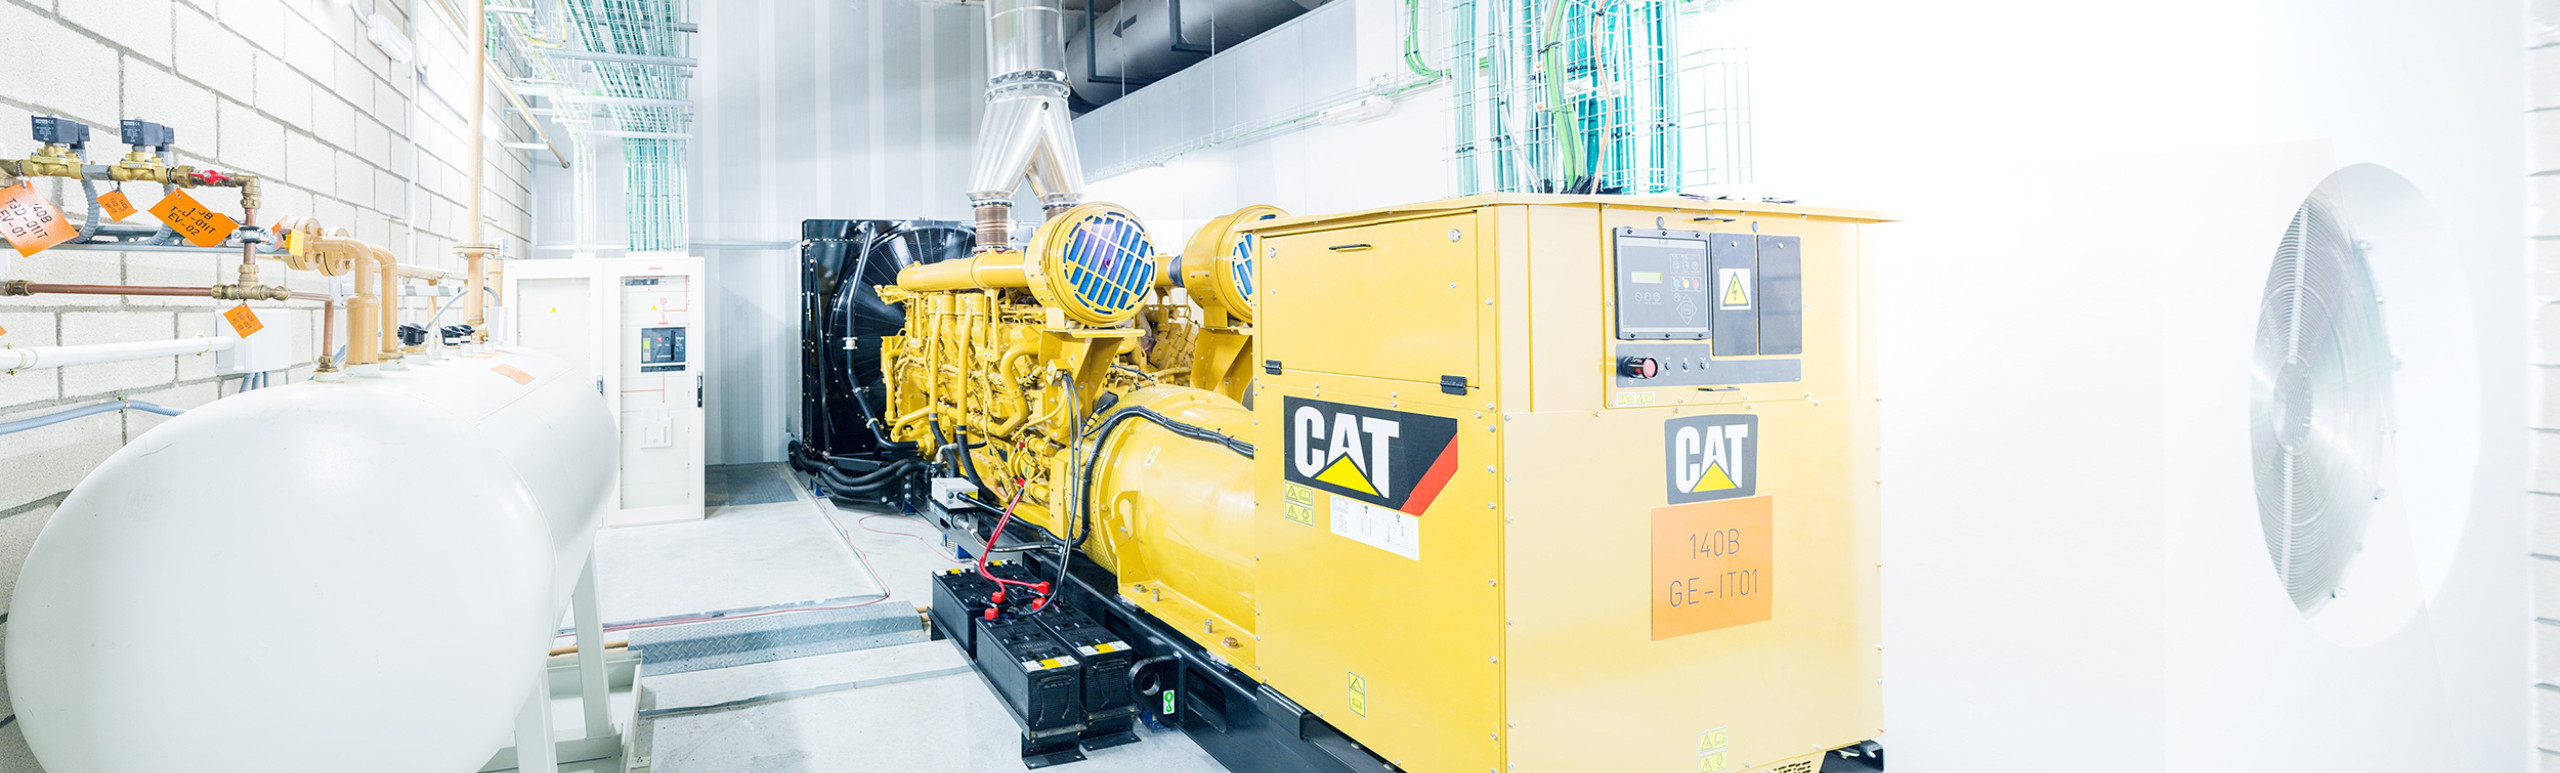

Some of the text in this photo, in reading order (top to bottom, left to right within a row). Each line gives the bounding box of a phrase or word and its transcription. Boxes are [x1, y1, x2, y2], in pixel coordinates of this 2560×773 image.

[168, 212, 200, 236] EV-02
[1294, 405, 1400, 499] CAT
[1675, 423, 1749, 494] CAT
[1689, 528, 1741, 560] 140B
[1669, 568, 1758, 608] GE-IT01
